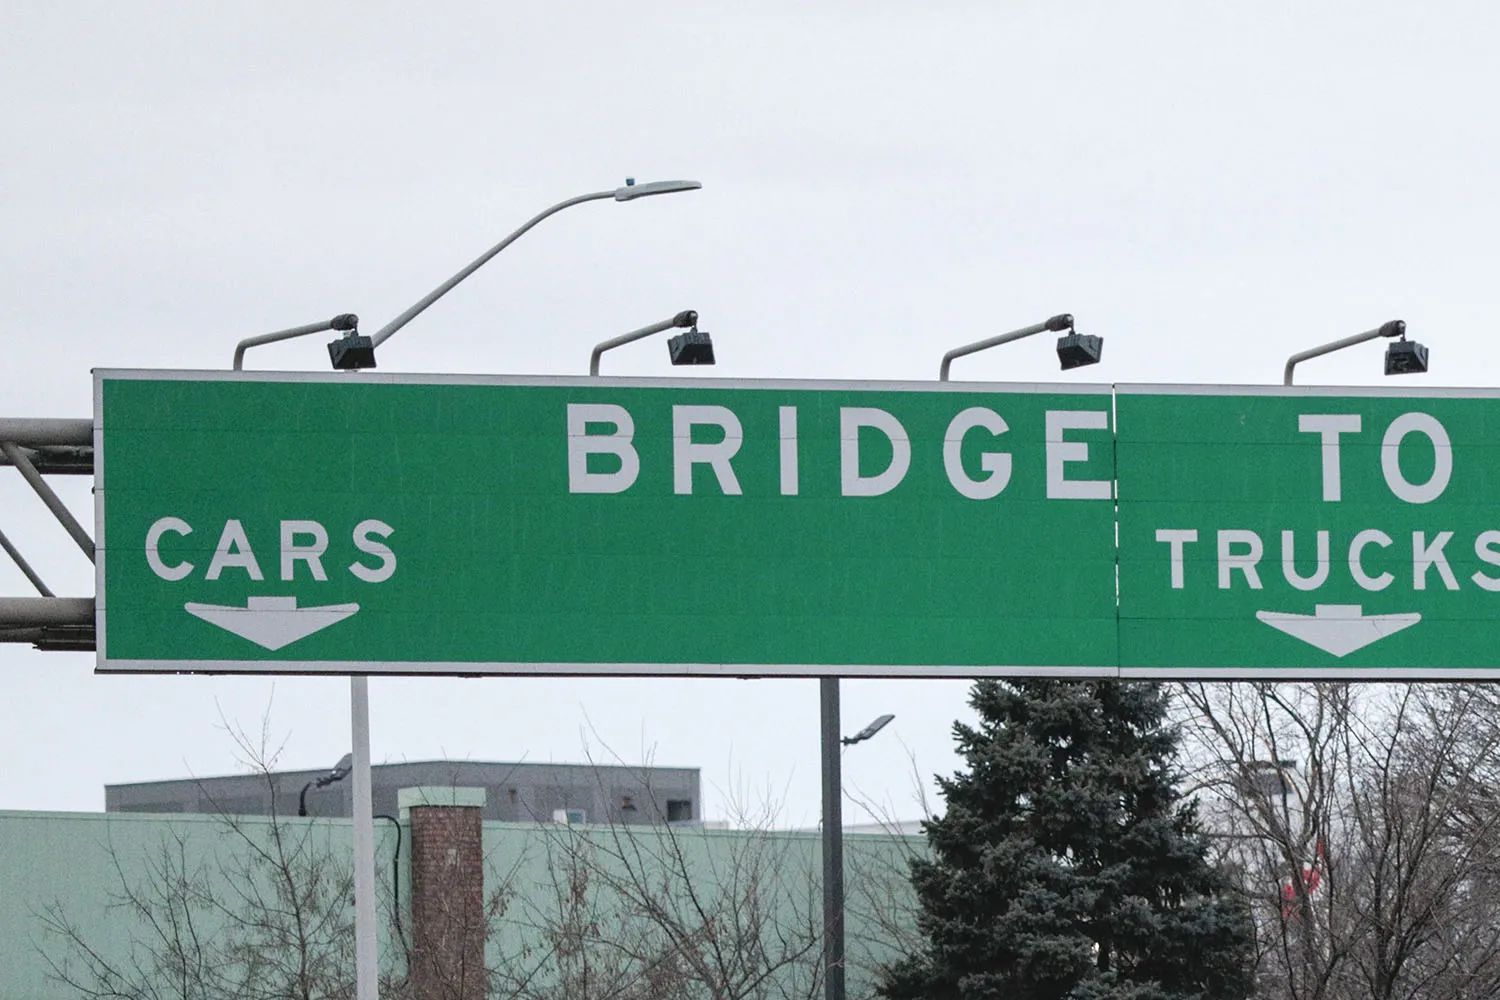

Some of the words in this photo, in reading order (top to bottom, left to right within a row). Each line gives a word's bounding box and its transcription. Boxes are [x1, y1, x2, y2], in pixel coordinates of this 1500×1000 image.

[567, 403, 1111, 501] BRIDGE
[1298, 411, 1454, 504] TO
[145, 516, 397, 582] CARS
